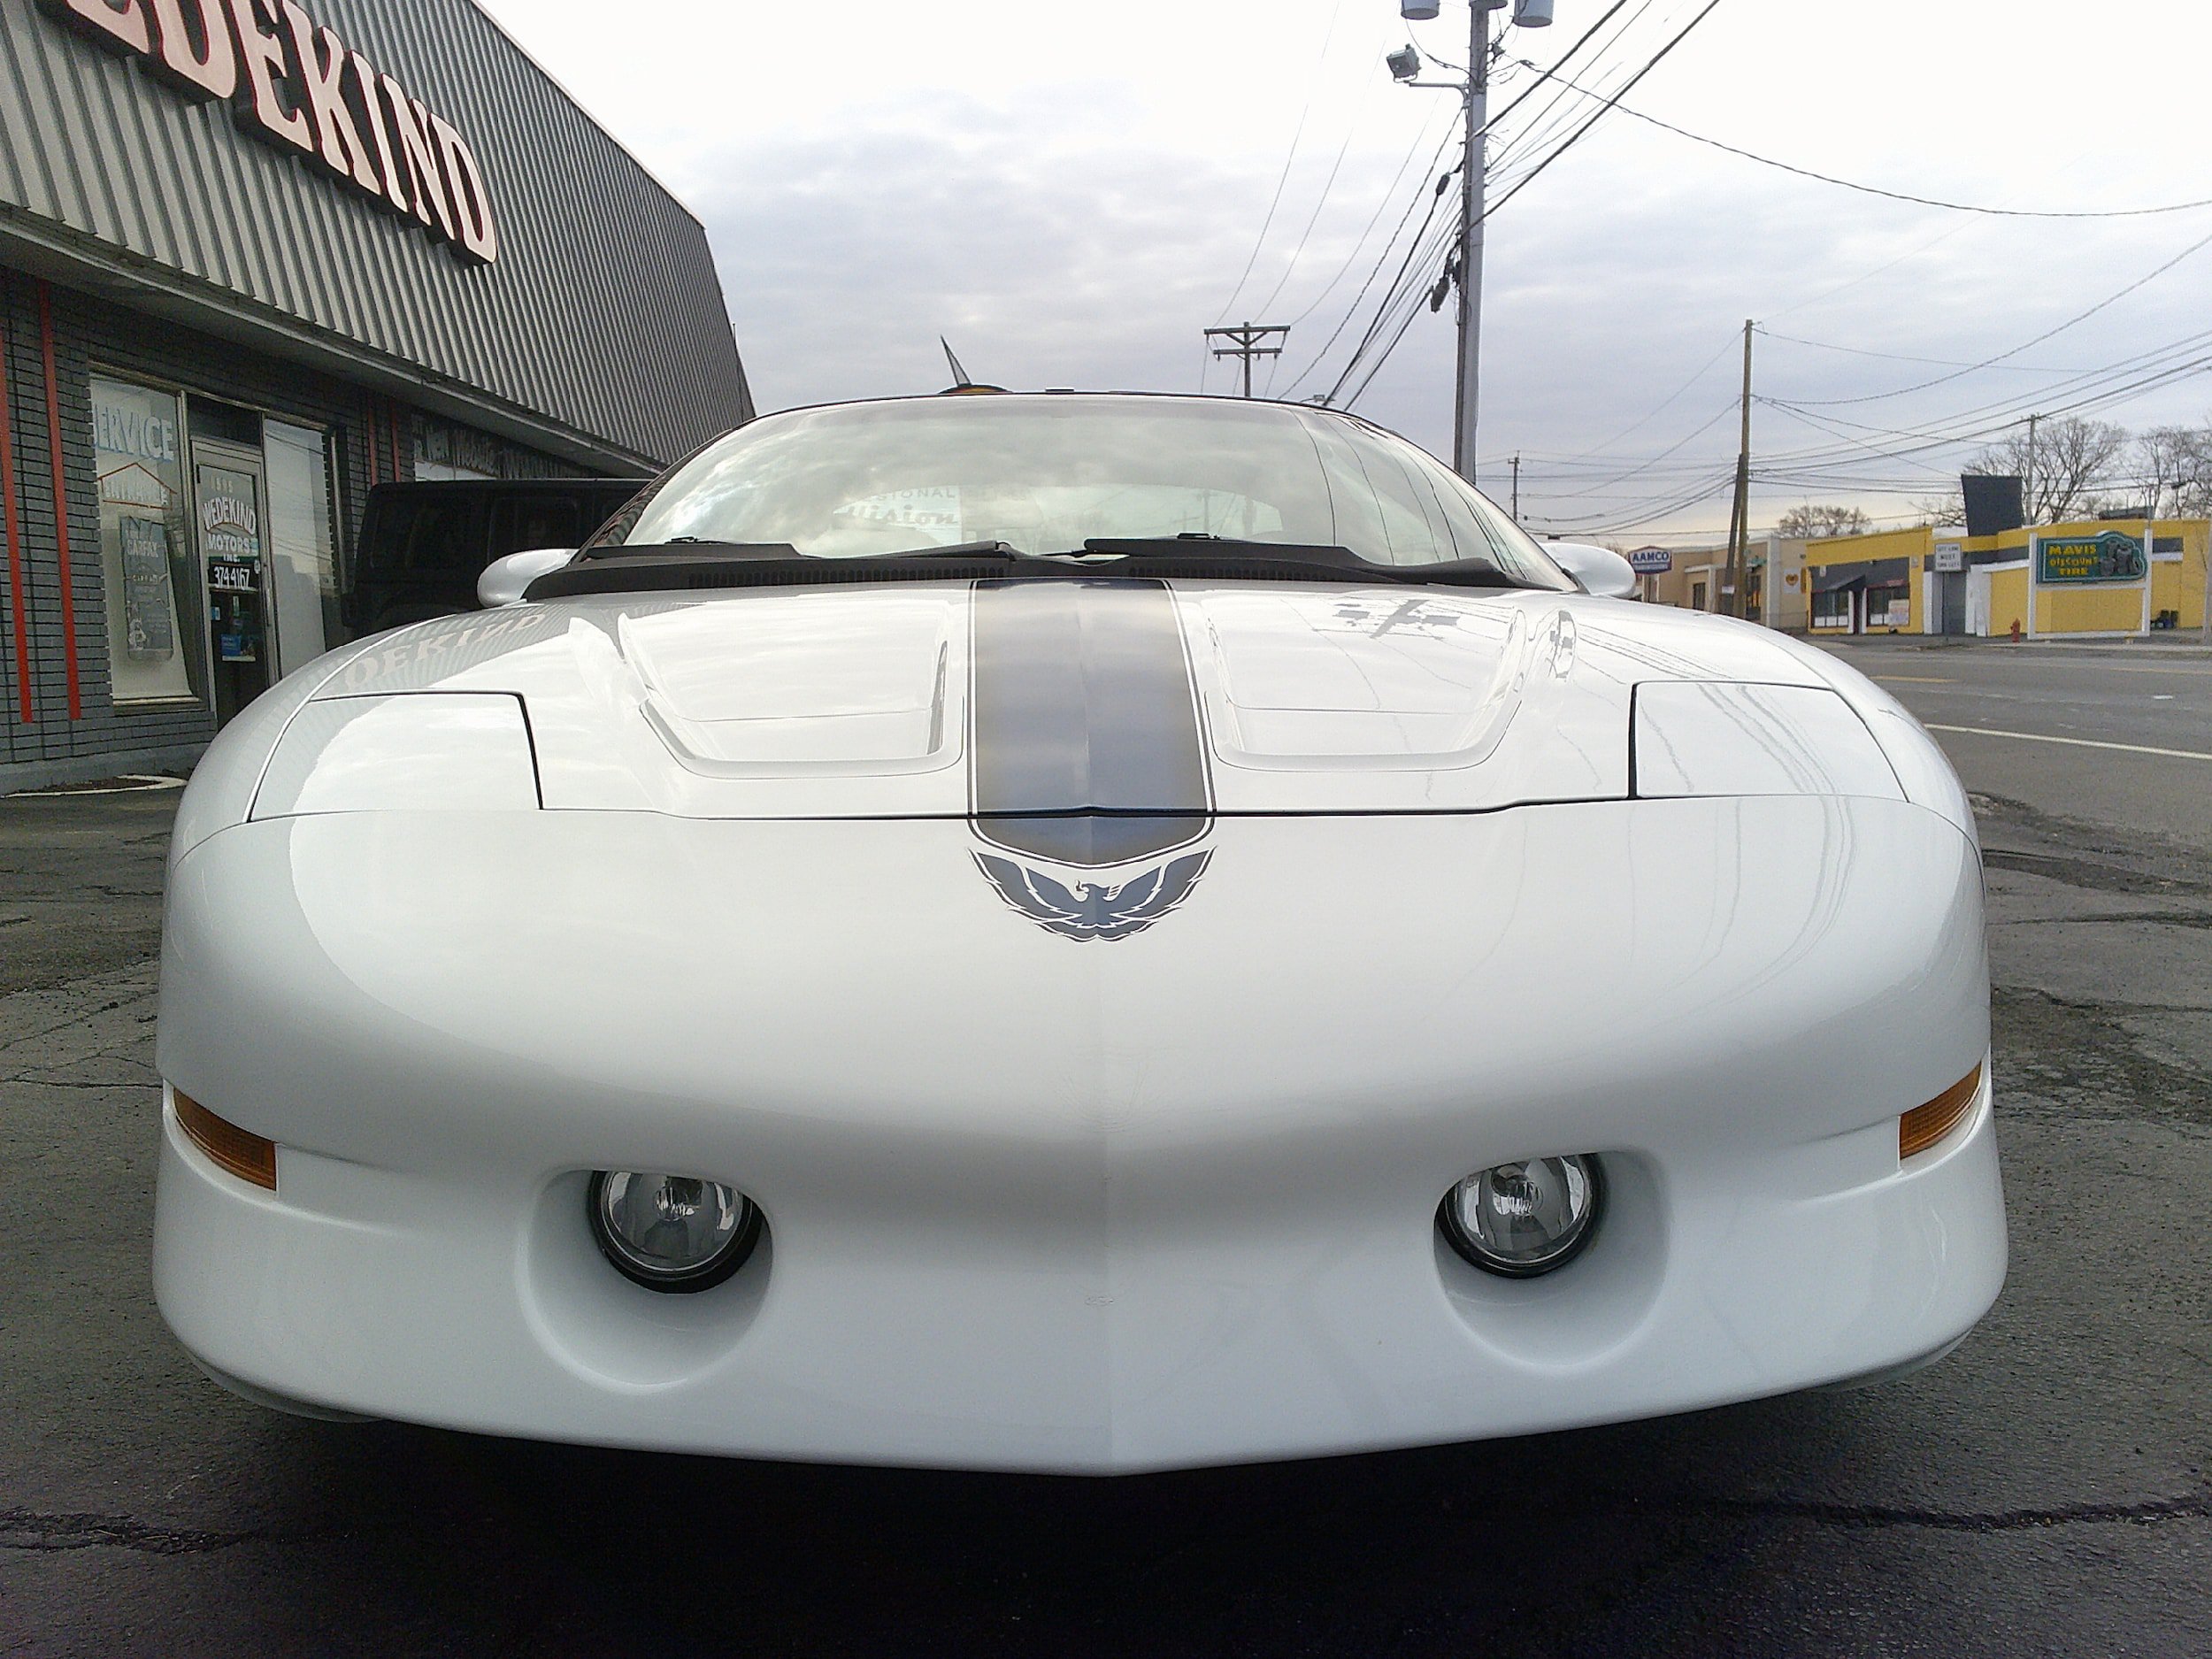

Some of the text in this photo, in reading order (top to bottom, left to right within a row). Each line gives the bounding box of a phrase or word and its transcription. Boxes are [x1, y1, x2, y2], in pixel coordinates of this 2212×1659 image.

[91, 403, 175, 463] ERVICE
[203, 496, 257, 535] WEDEKIND
[207, 534, 250, 554] MOTORS
[2048, 543, 2097, 556] MAVIS
[1632, 551, 1669, 562] AAMCO
[2049, 556, 2098, 567] DISCOUNT
[2059, 566, 2088, 576] TIRE
